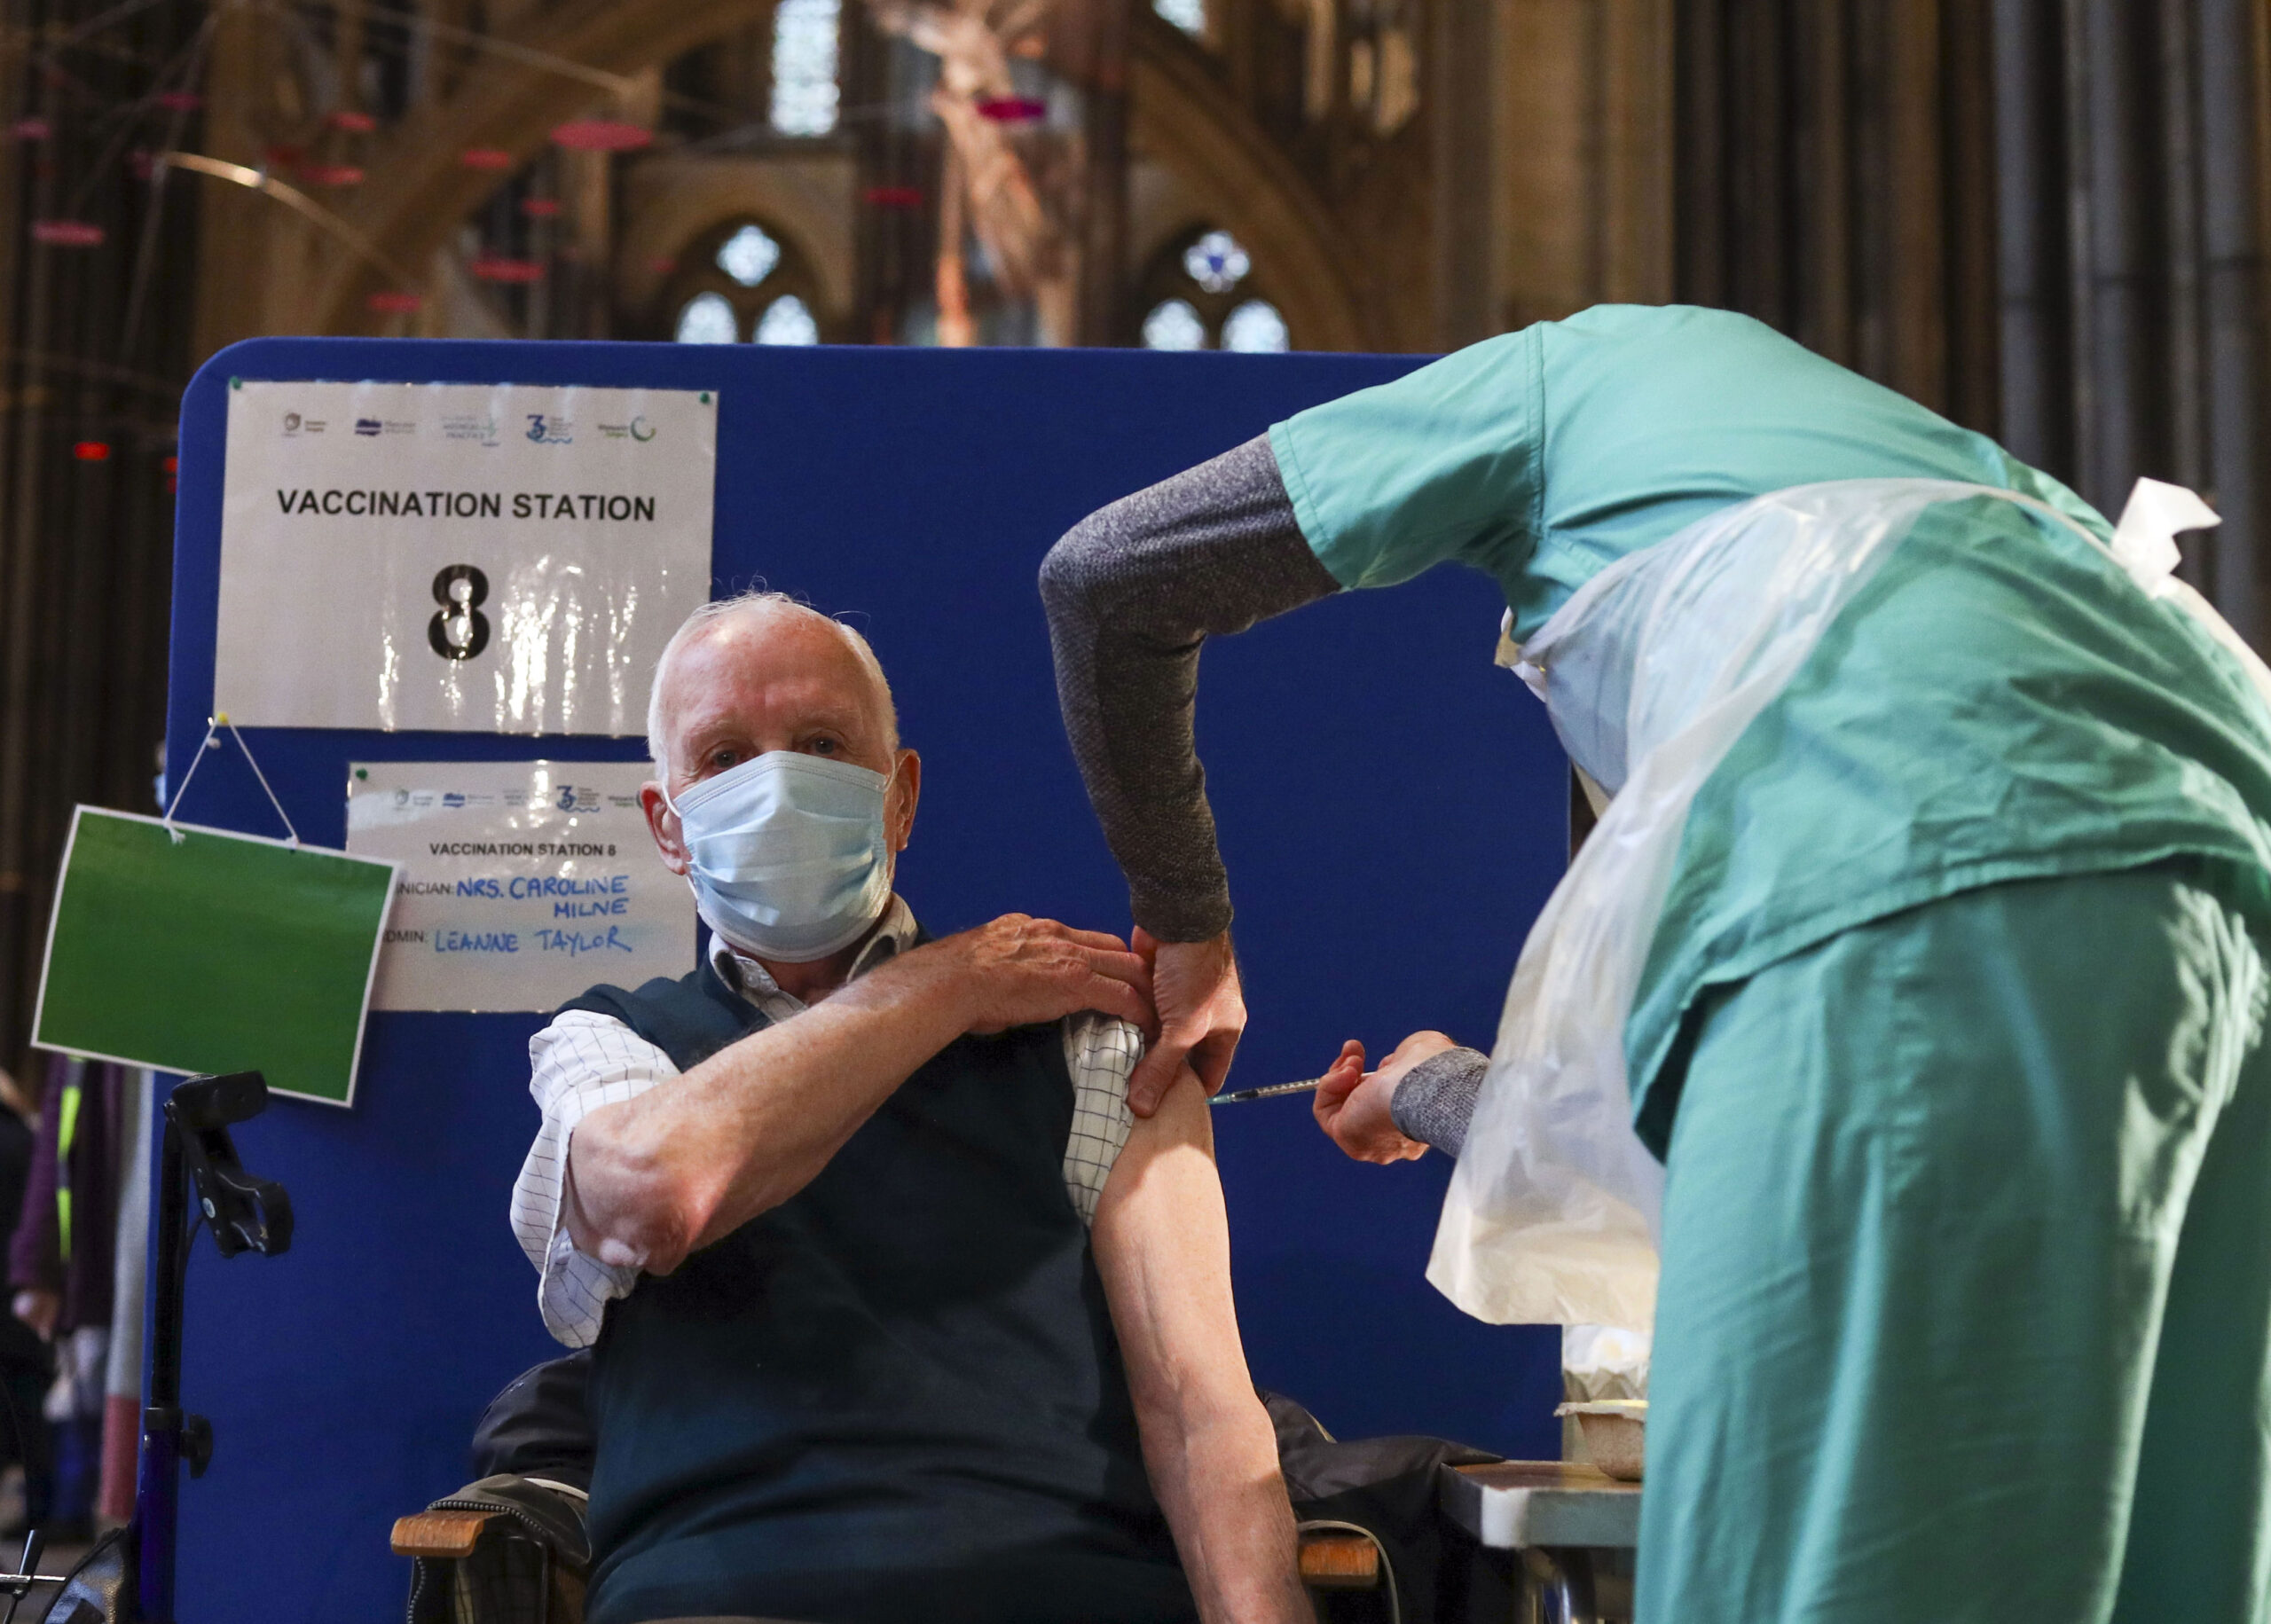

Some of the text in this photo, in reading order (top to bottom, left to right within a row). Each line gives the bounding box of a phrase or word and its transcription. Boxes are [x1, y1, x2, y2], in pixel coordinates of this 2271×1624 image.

[278, 489, 656, 522] VACCINATION STATION
[428, 563, 490, 660] 8
[430, 843, 617, 857] VACCINATION STATION 8
[397, 882, 454, 895] NICIAN:
[509, 875, 629, 899] CAROLINE
[554, 898, 629, 918] MILNE
[435, 925, 633, 957] LEANNE TAYLOR
